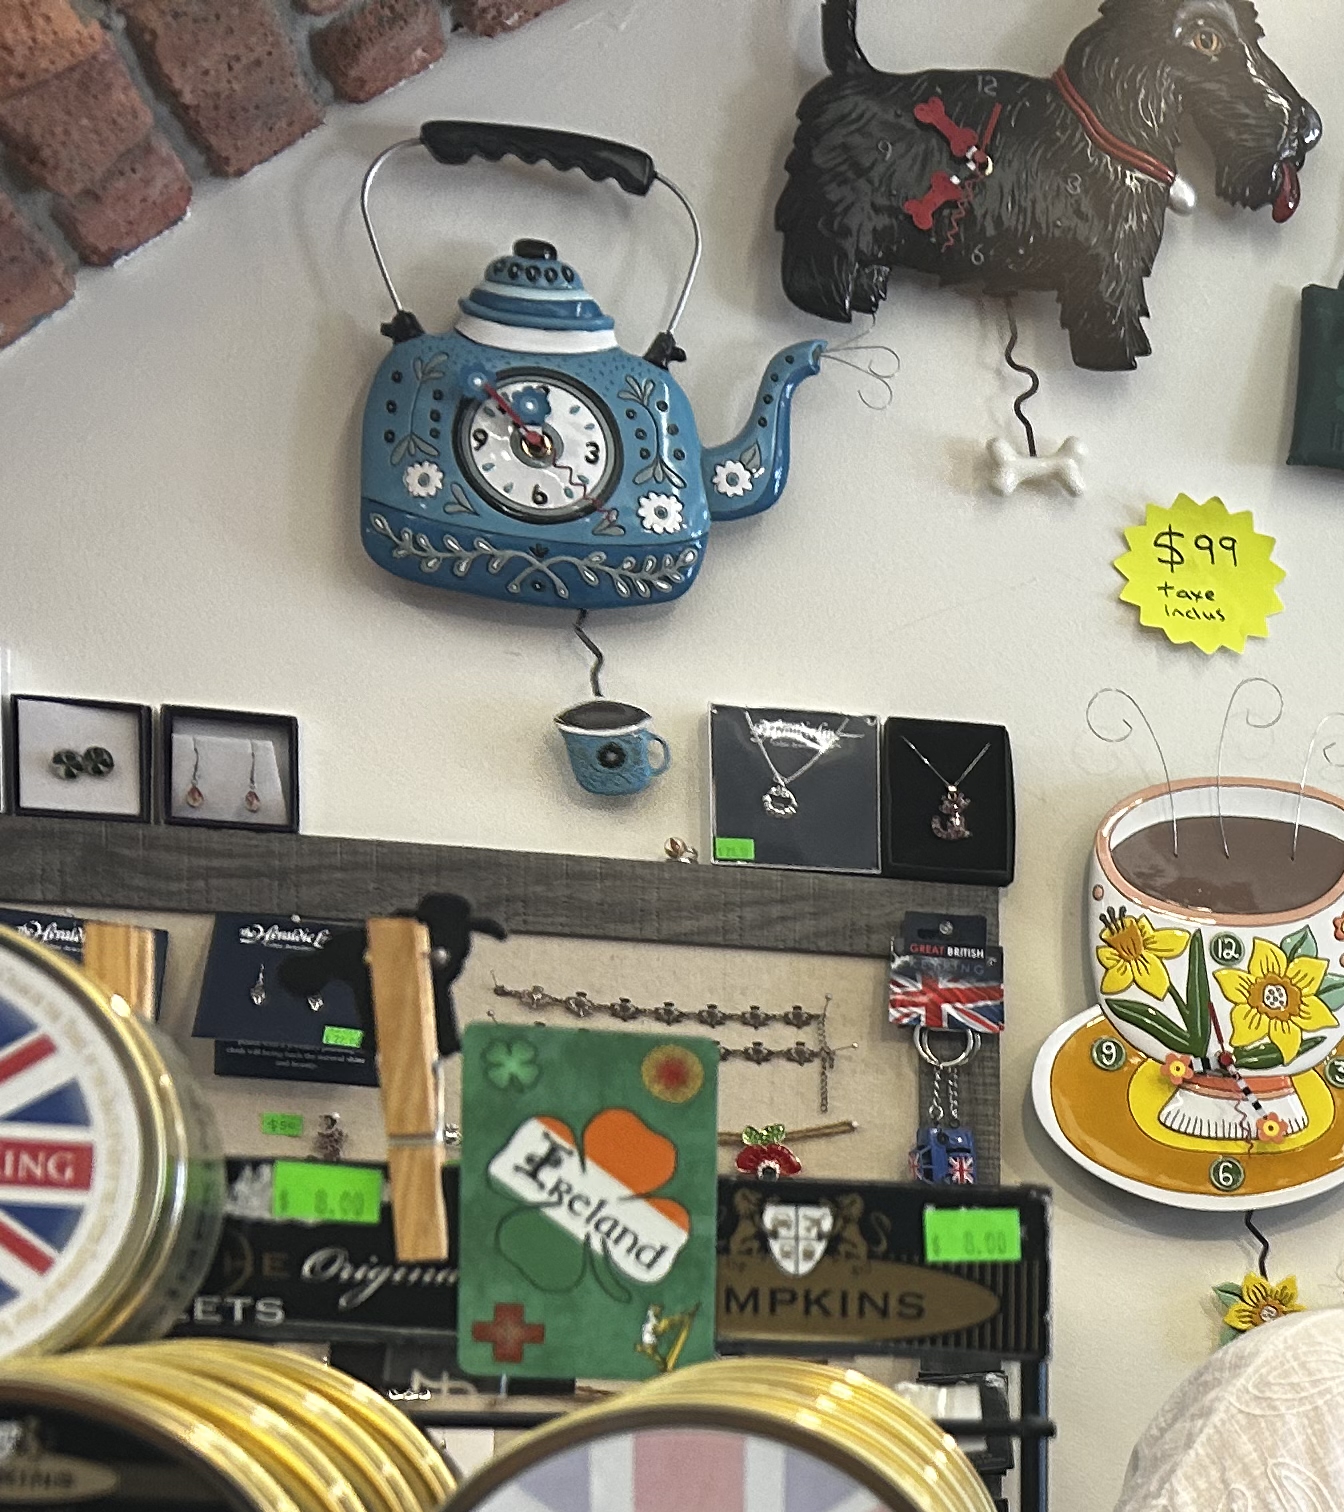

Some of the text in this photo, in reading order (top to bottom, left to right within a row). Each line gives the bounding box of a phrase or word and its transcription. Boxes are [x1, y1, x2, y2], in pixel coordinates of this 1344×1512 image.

[471, 429, 488, 449] 9
[585, 444, 600, 464] 3
[532, 487, 547, 507] 6
[1157, 581, 1216, 603] taxe
[910, 943, 985, 960] GREAT BRITISH
[1218, 938, 1240, 960] 12
[1100, 1041, 1115, 1066] 9
[1, 1150, 75, 1182] ING
[1219, 1163, 1234, 1187] 6
[724, 1286, 927, 1320] MPKINS
